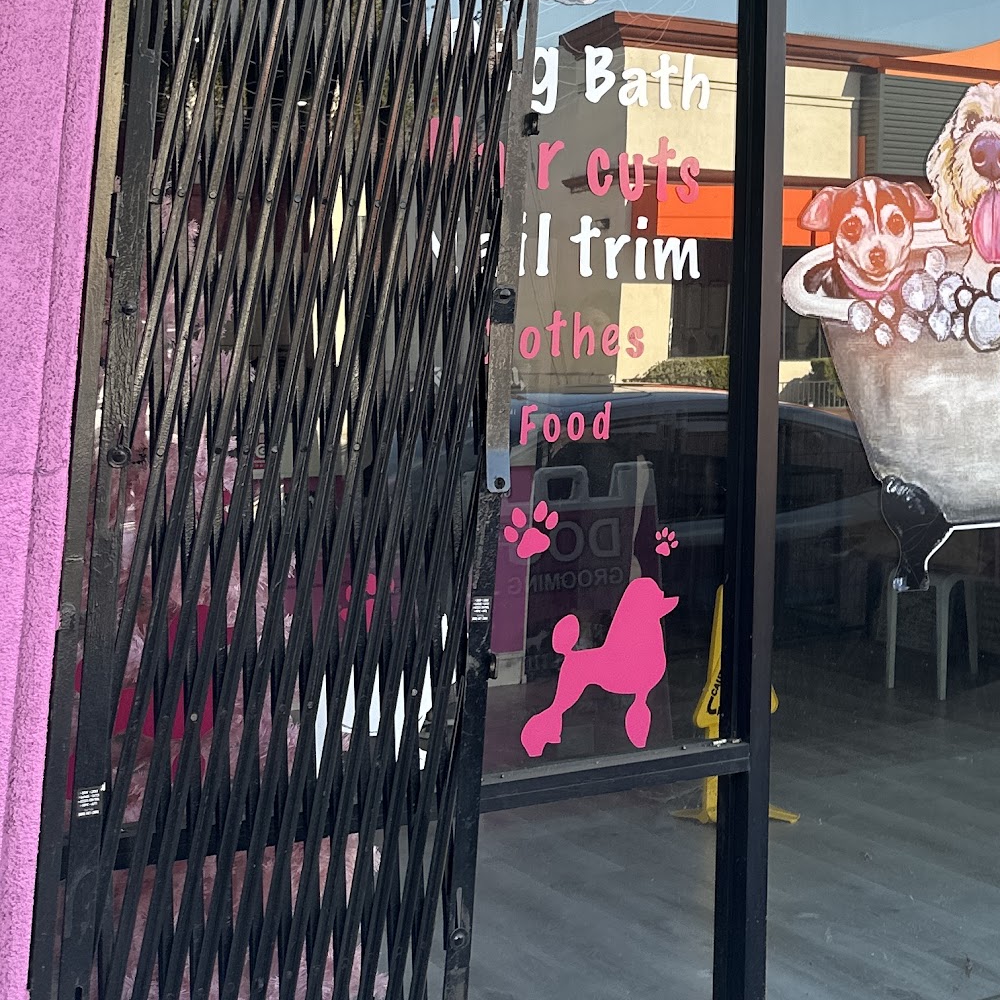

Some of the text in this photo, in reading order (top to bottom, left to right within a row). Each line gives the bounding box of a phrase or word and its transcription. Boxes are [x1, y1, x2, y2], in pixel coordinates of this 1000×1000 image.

[583, 44, 711, 111] Bath
[587, 136, 701, 205] cuts
[570, 213, 702, 281] trim
[519, 401, 612, 446] Food
